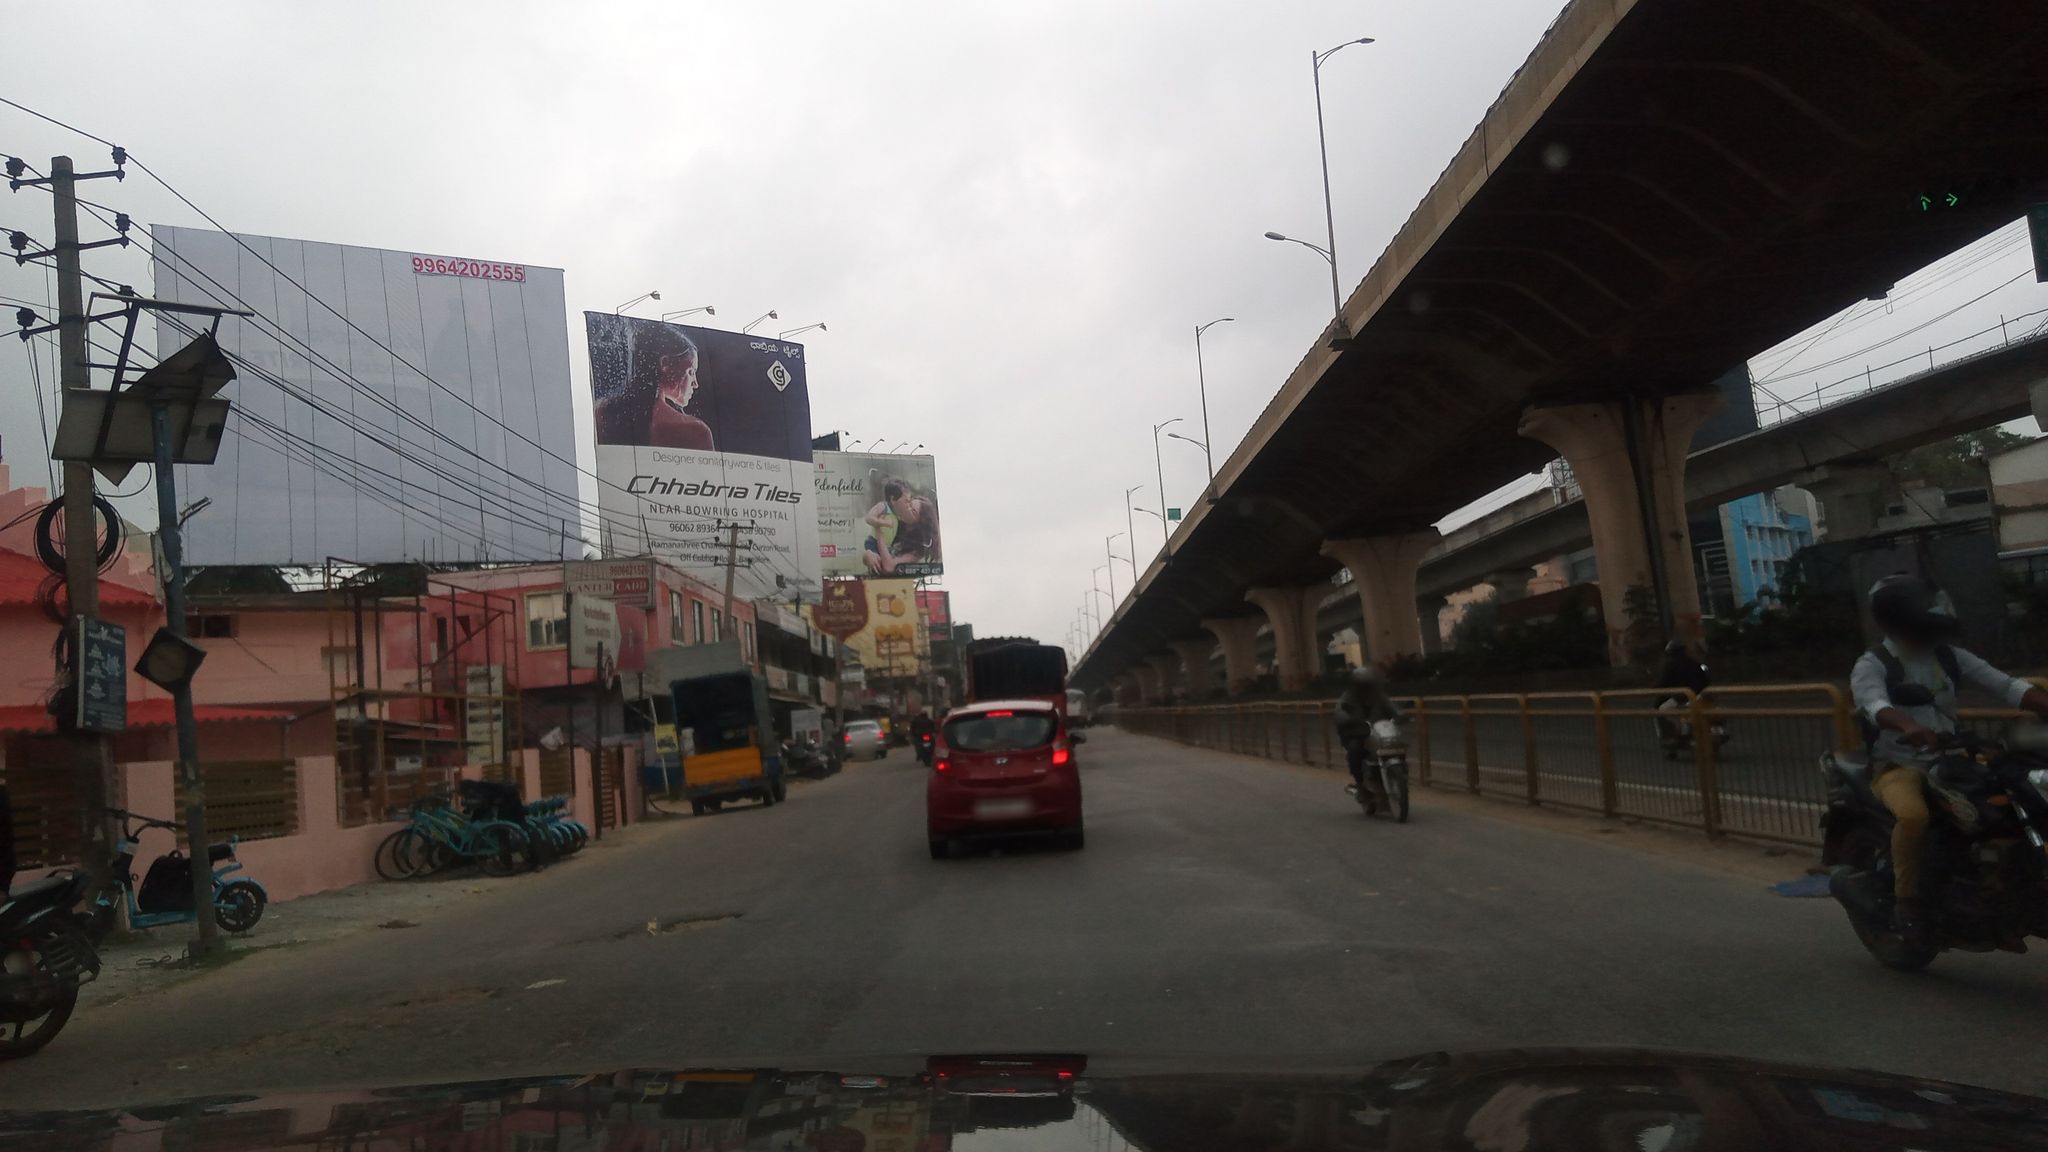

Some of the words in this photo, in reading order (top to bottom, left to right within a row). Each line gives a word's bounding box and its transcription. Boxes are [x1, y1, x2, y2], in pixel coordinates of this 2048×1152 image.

[412, 257, 524, 281] 9964202555
[652, 451, 694, 466] Designer
[627, 476, 749, 499] Chhabria
[754, 482, 802, 504] Tiles
[649, 504, 681, 514] NEAR
[686, 505, 738, 517] BOWRING
[743, 508, 788, 521] HOSPITAL
[669, 523, 694, 532] 96062
